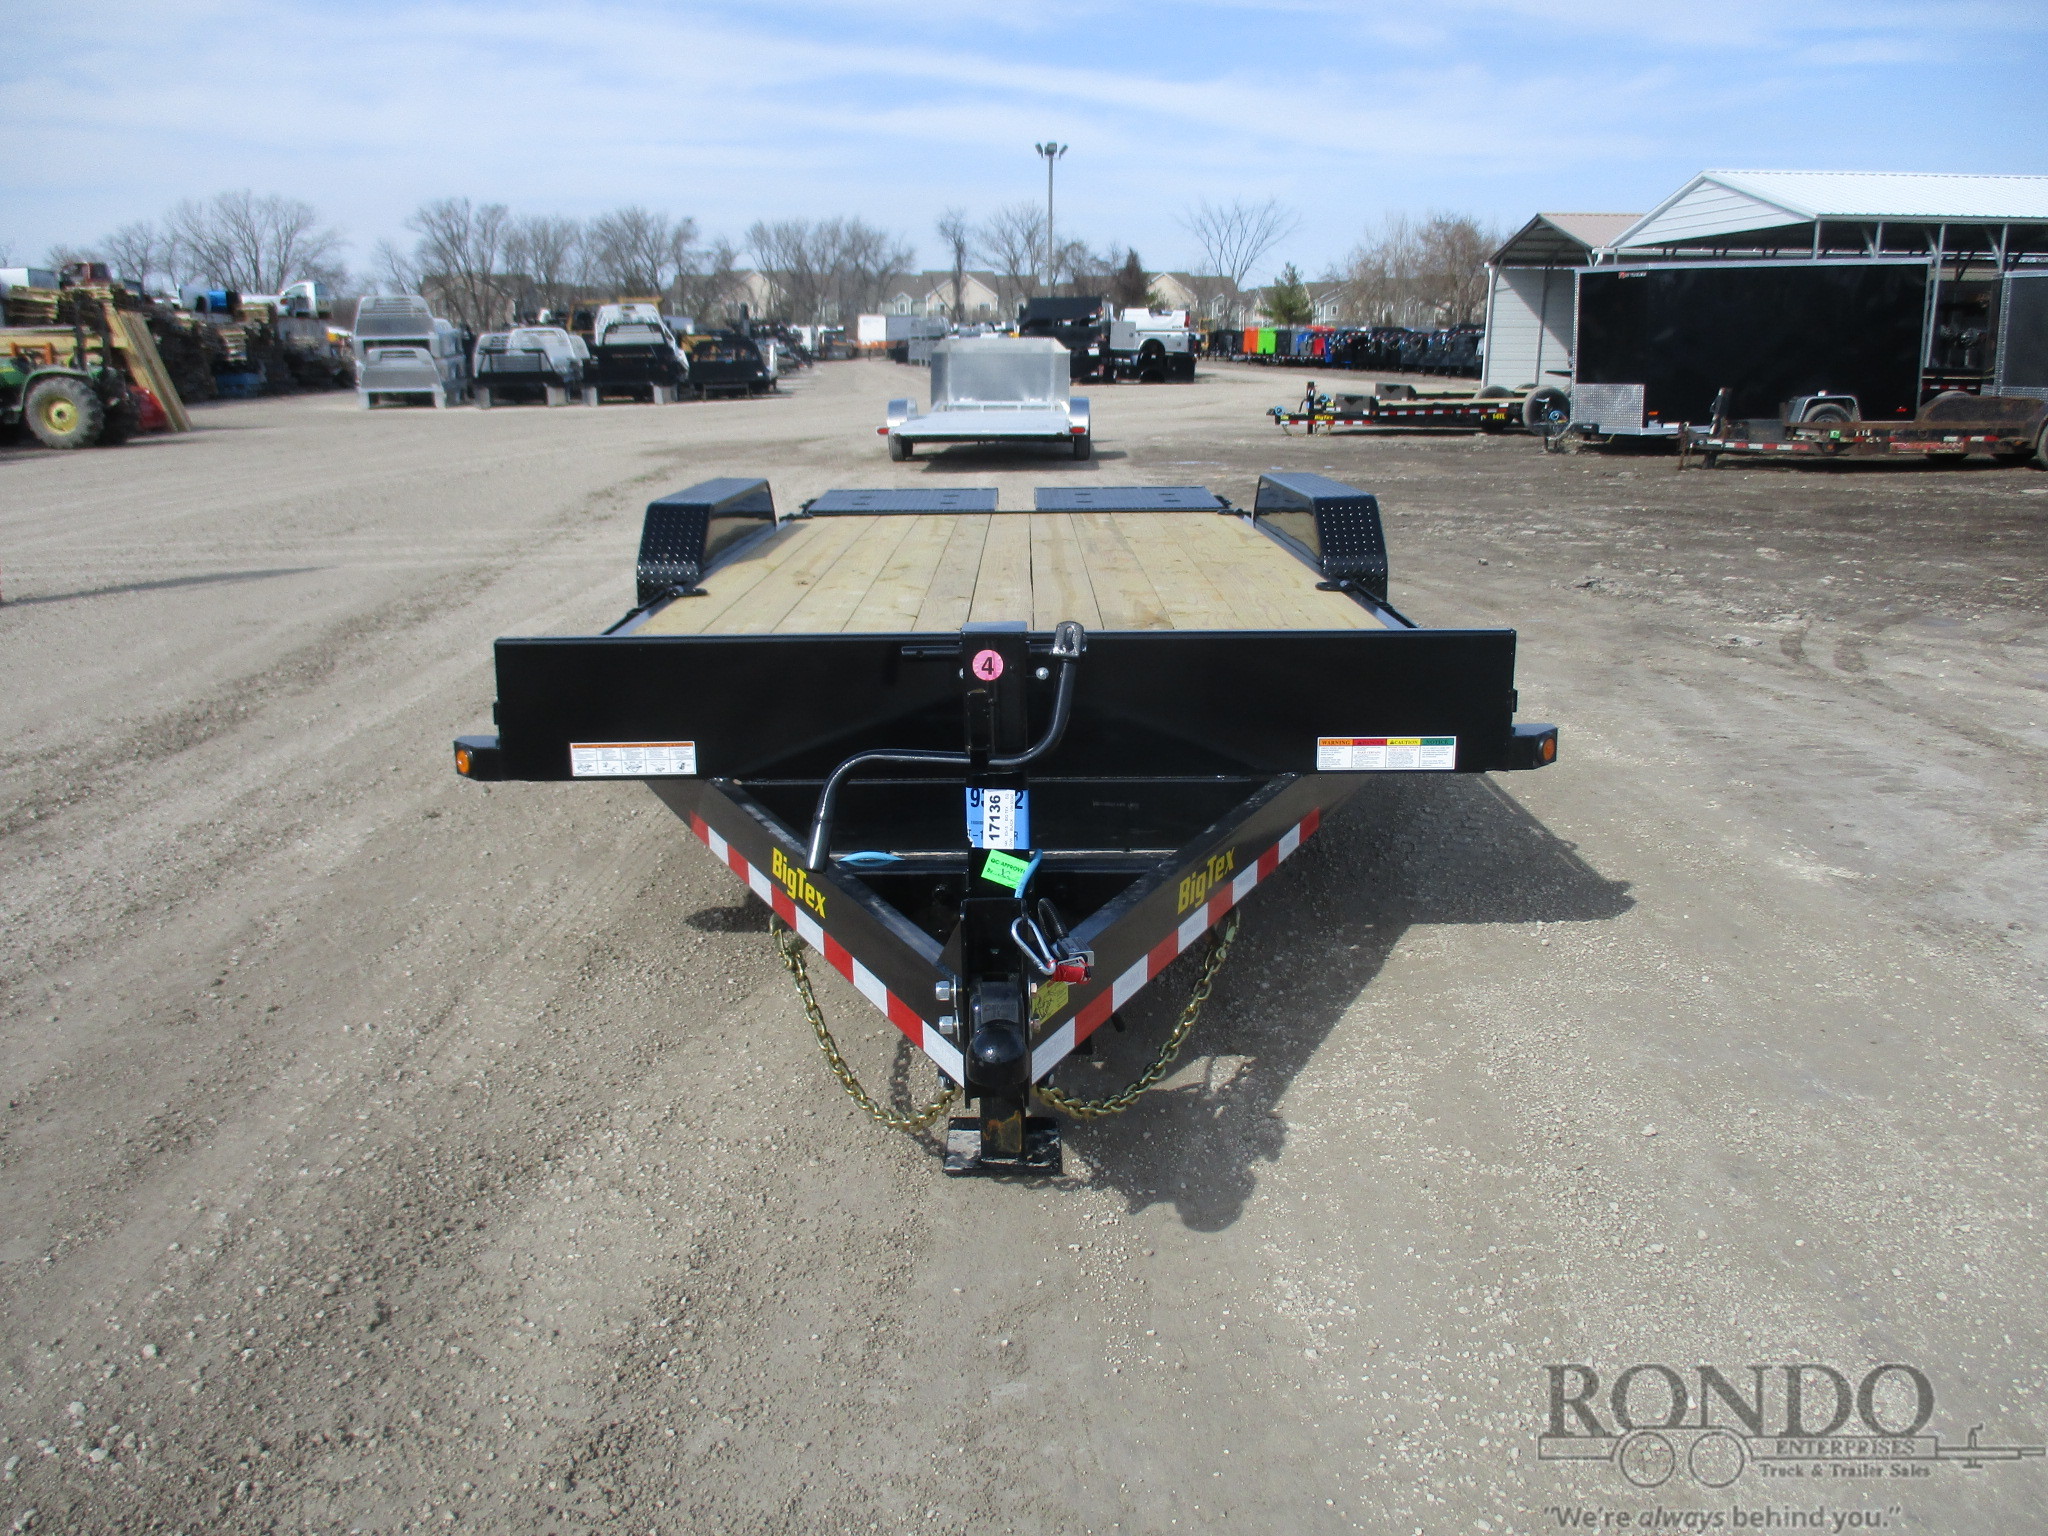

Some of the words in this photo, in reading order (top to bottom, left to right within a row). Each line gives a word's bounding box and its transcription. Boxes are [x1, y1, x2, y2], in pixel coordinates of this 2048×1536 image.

[981, 656, 994, 676] 4
[988, 795, 1001, 840] 17136
[772, 847, 826, 918] BigTex
[1178, 847, 1235, 915] BigTex
